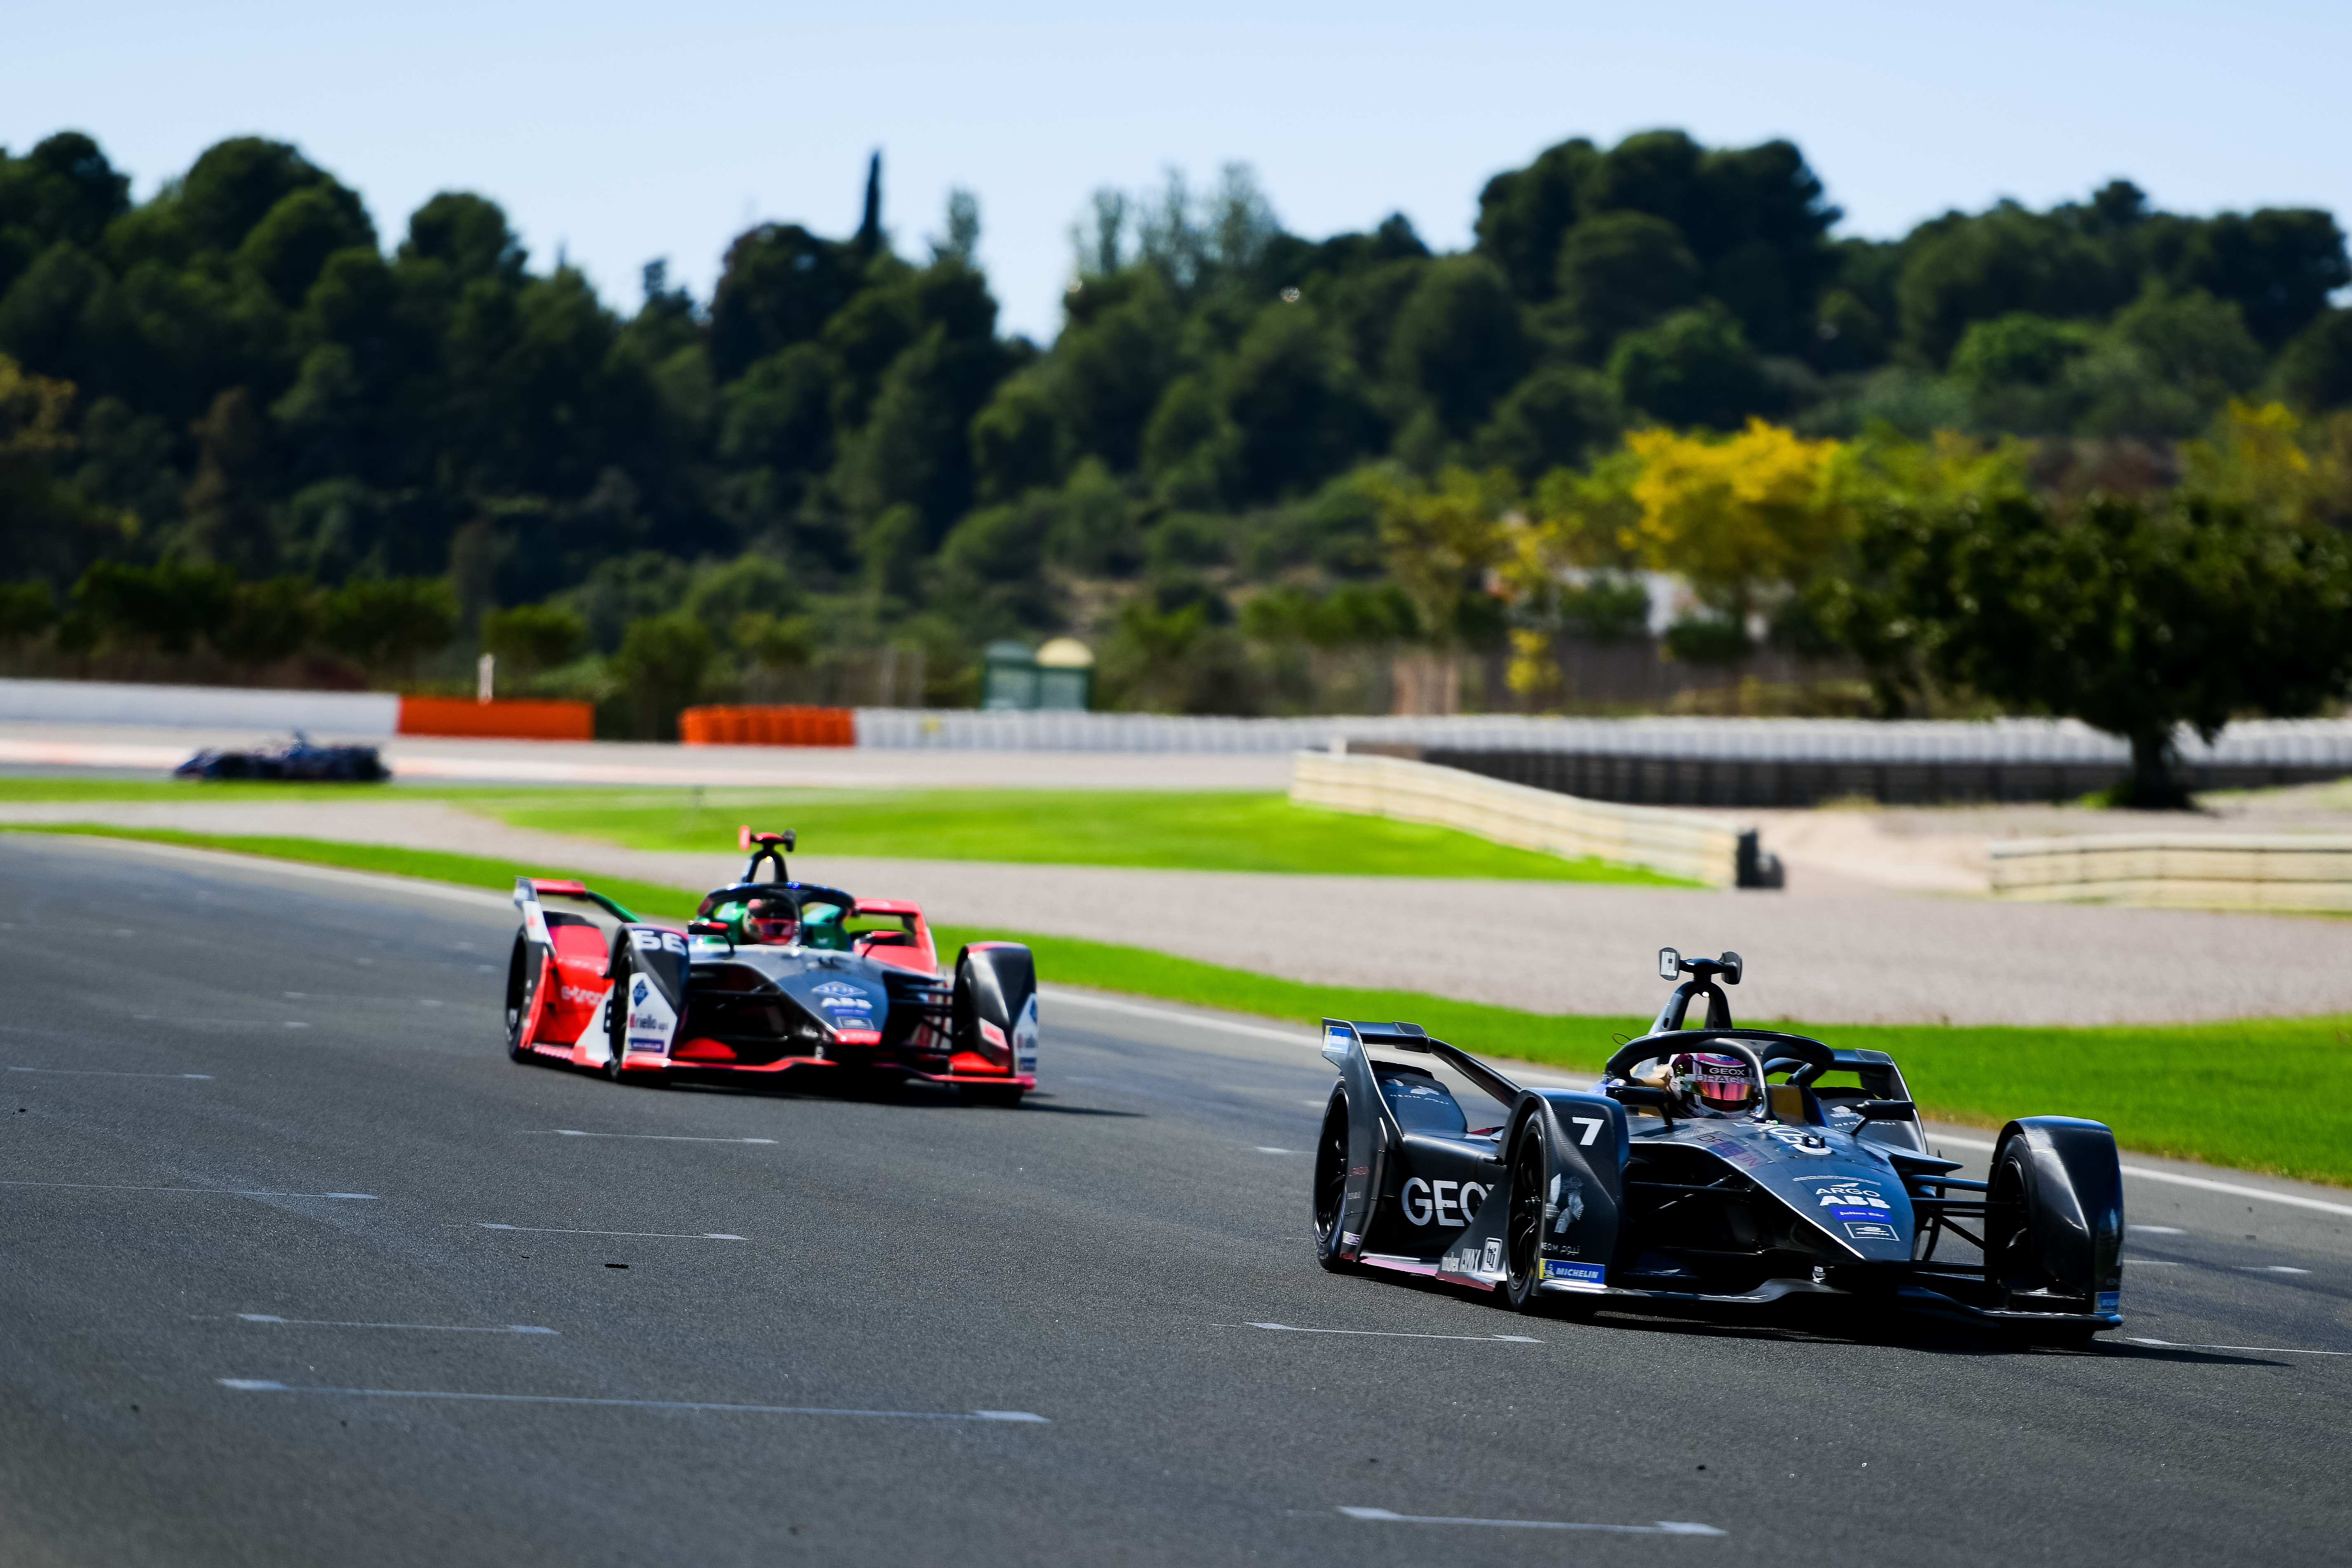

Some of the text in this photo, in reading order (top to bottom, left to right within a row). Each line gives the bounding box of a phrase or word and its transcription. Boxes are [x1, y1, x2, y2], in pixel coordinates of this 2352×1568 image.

[1572, 1117, 1605, 1145] 7
[1815, 1188, 1880, 1197] ARGO
[1819, 1195, 1891, 1209] ABB
[1556, 1268, 1599, 1278] MICHELIN
